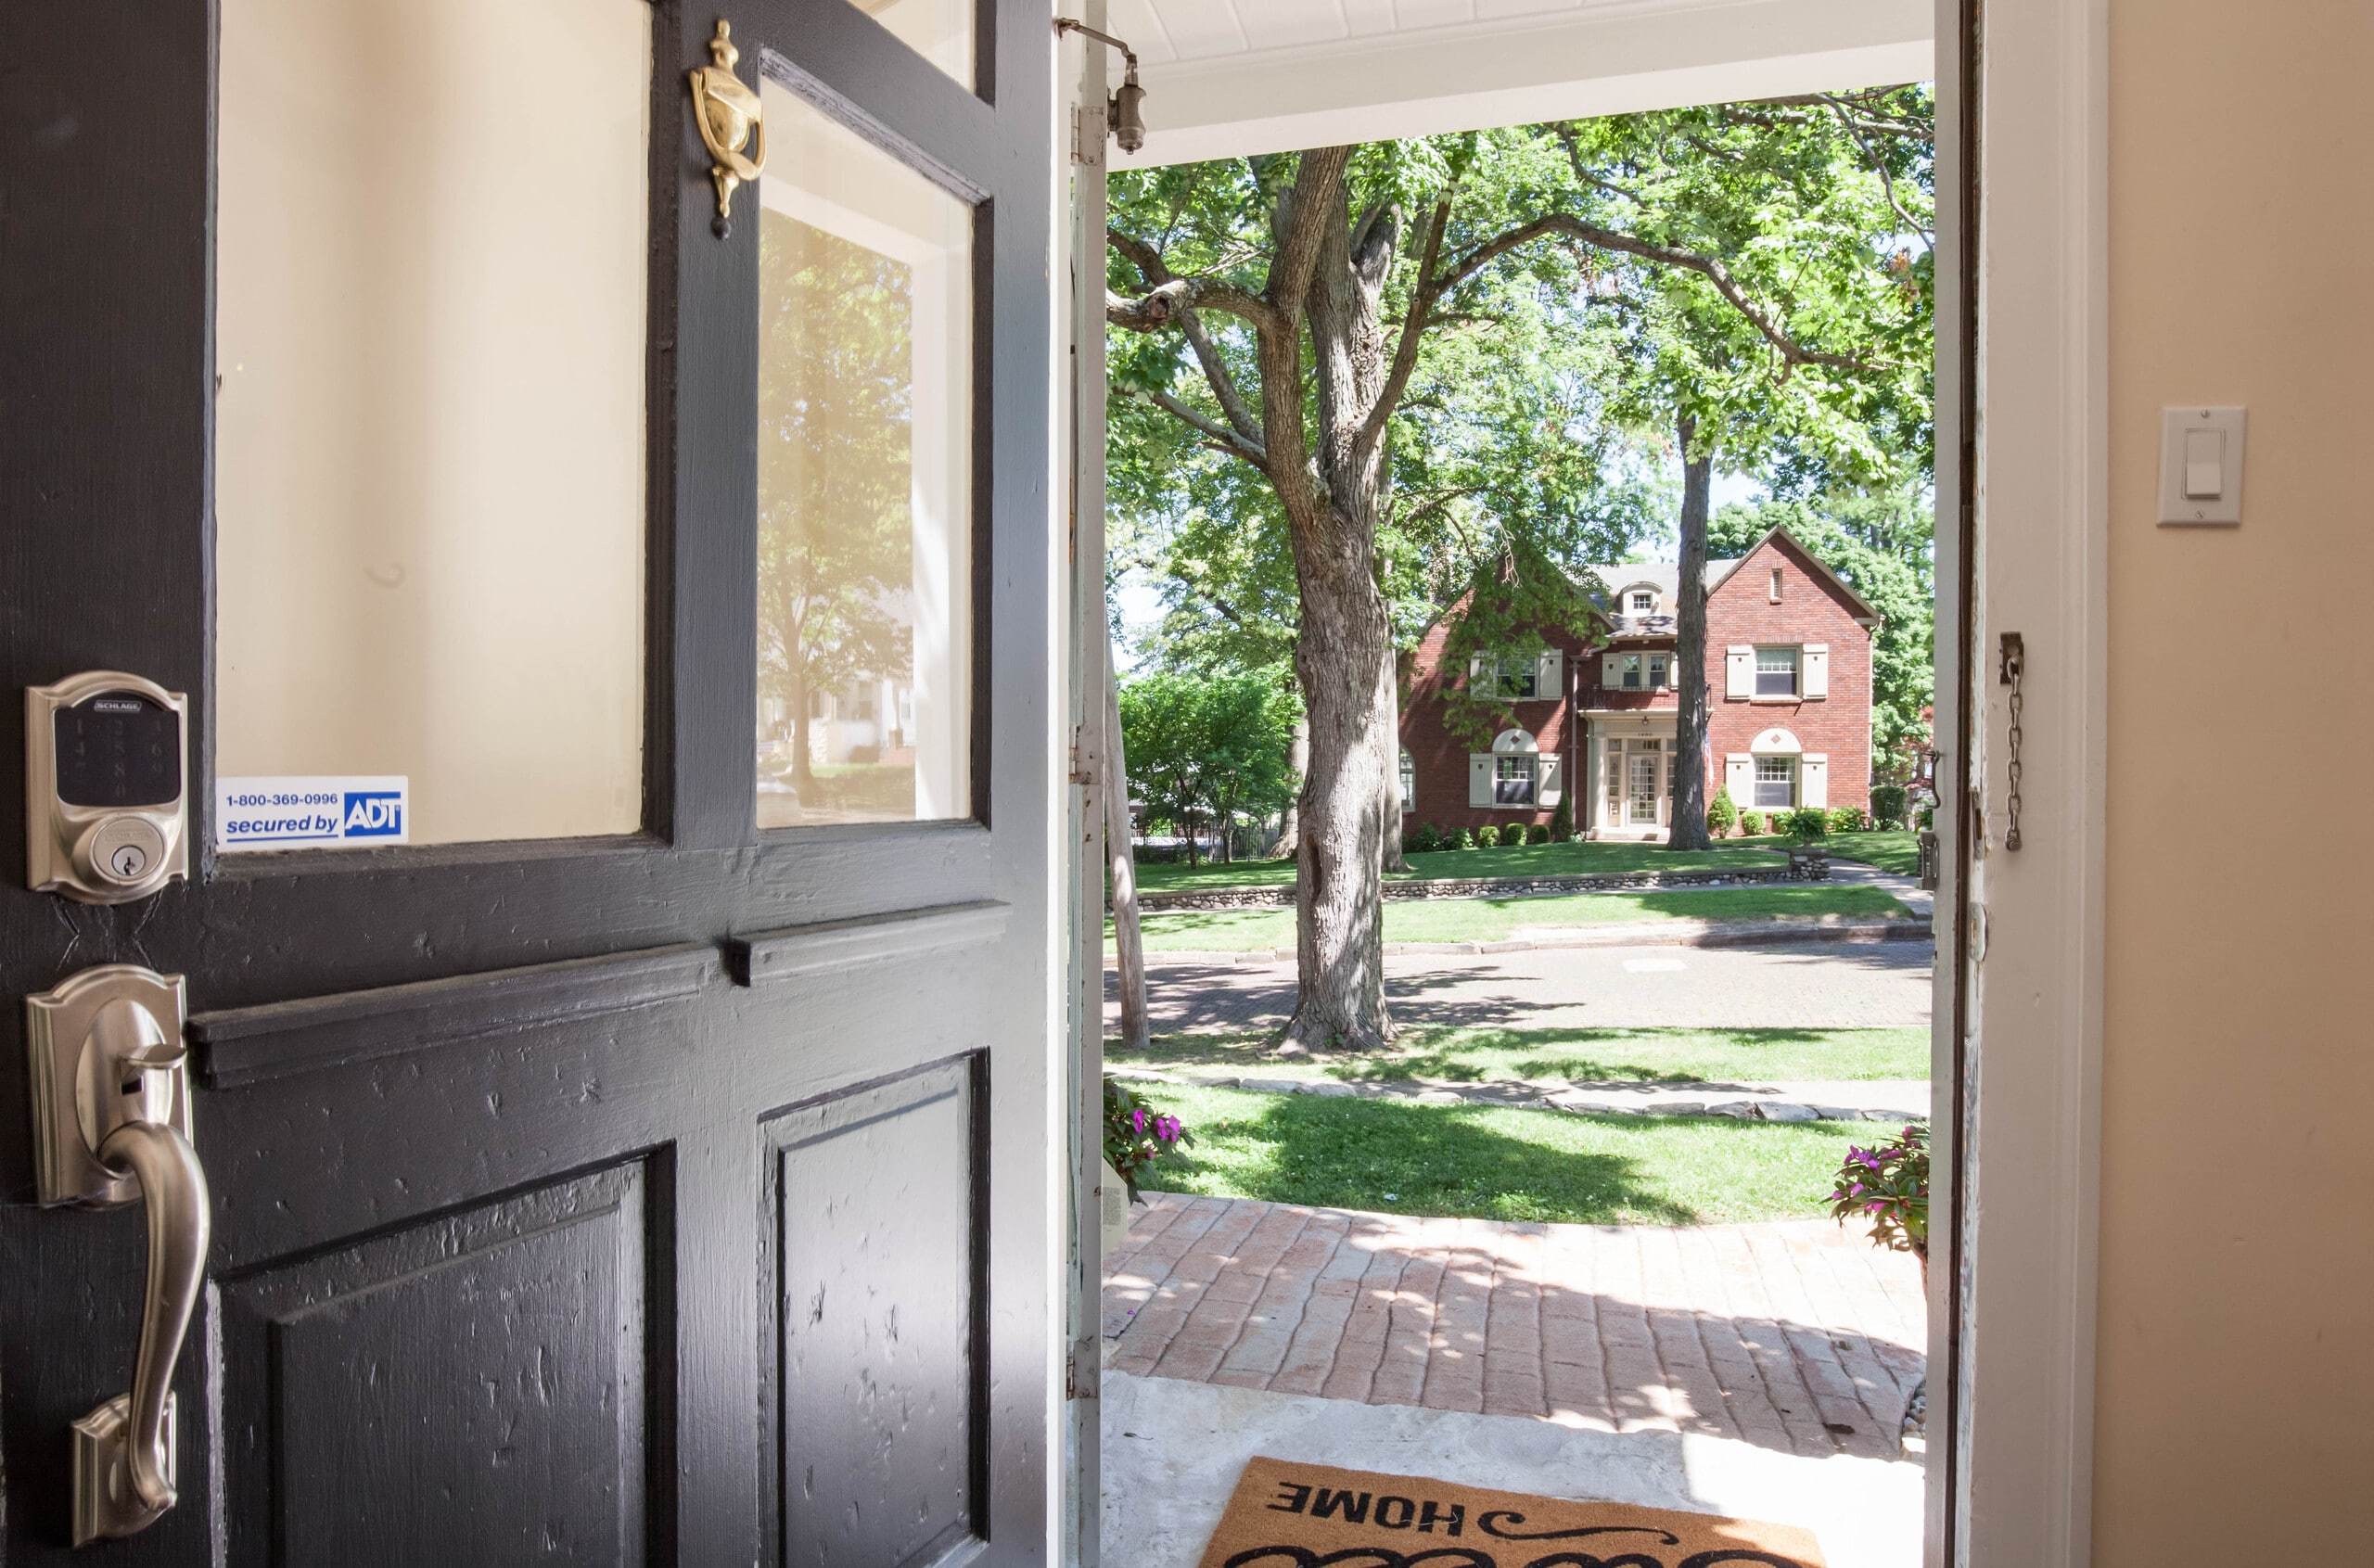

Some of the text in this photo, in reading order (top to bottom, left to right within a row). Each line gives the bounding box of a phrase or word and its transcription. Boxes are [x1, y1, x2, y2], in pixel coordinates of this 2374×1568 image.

[225, 793, 338, 807] 1-800-369-0996
[226, 814, 338, 834] secured by
[345, 797, 400, 831] ADT
[1267, 1482, 1465, 1537] HOME
